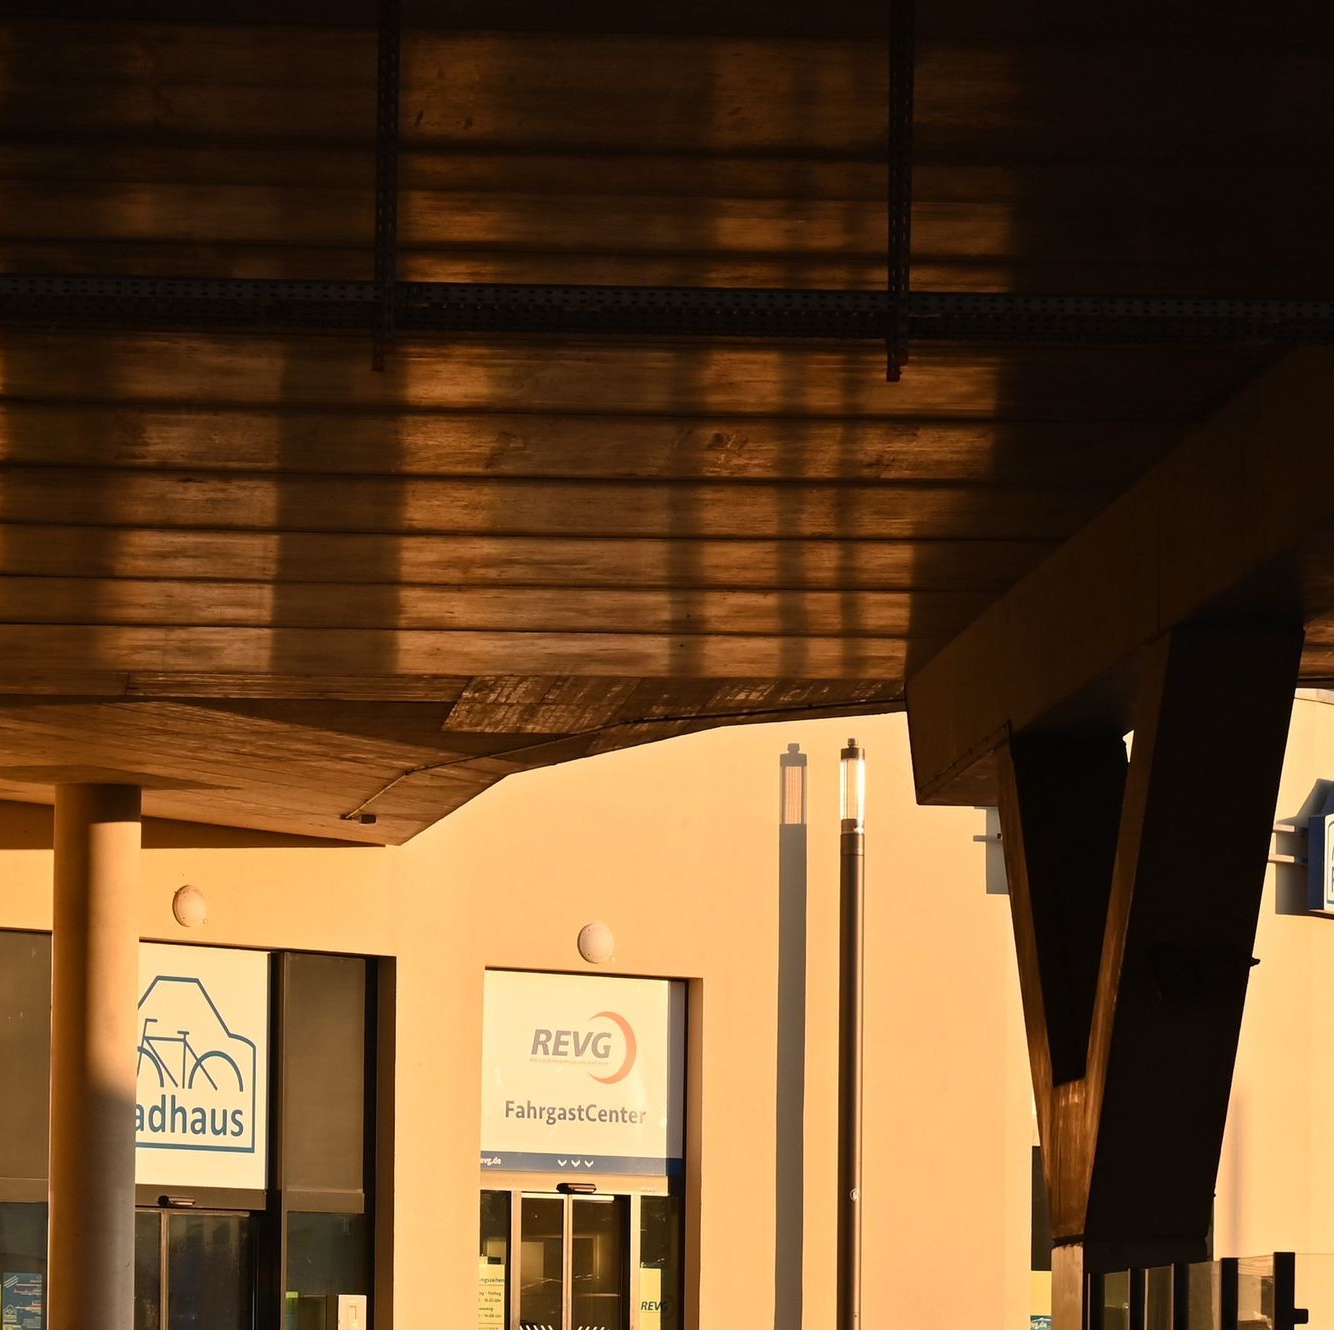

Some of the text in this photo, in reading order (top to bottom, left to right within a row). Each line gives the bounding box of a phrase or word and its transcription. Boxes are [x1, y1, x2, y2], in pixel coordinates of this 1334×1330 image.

[530, 1029, 612, 1058] REVG
[135, 1094, 244, 1137] adhaus
[505, 1099, 647, 1125] FahrgastCenter
